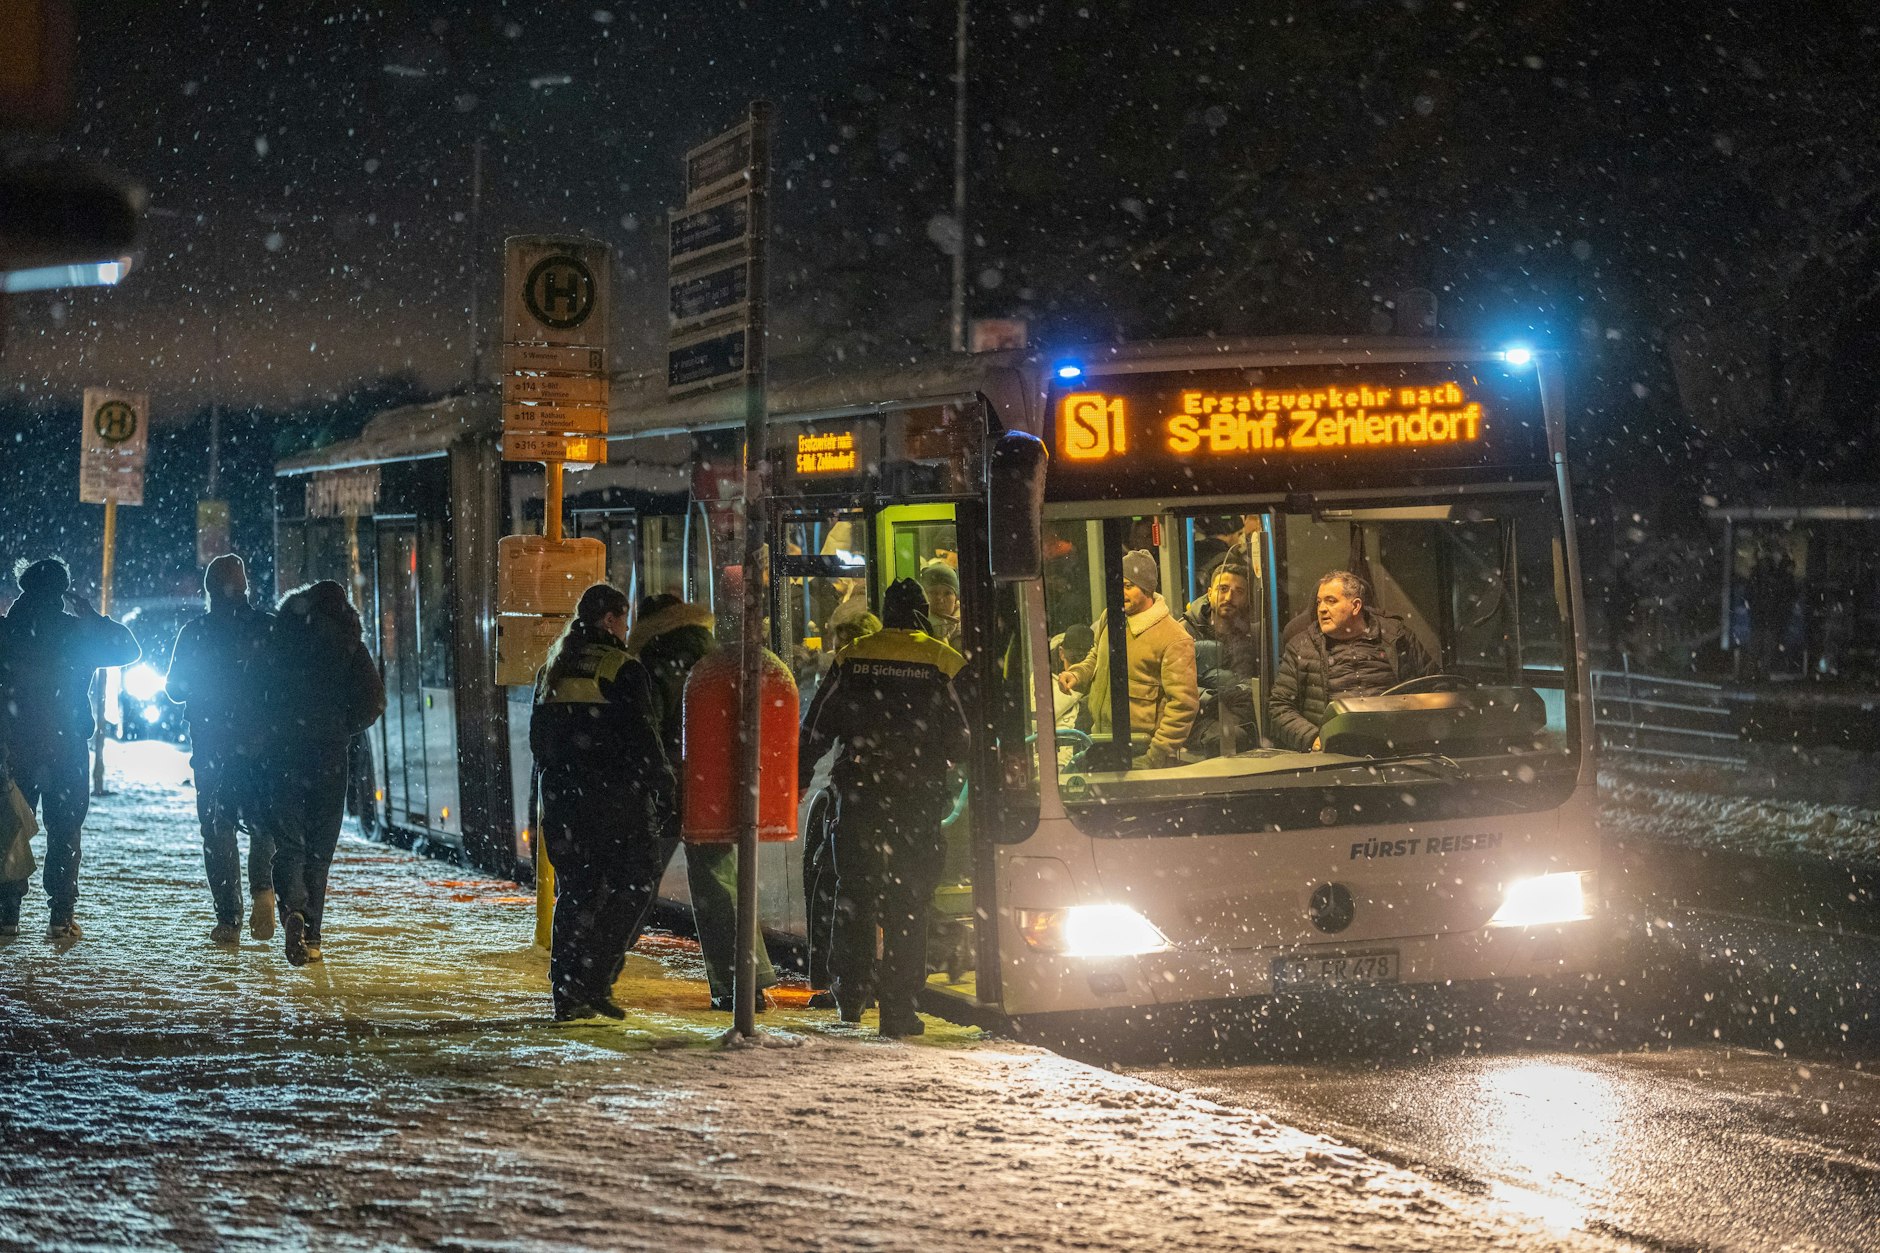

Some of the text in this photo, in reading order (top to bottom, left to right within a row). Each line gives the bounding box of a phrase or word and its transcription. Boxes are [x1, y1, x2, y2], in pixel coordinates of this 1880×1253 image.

[545, 272, 577, 312] H
[522, 382, 536, 391] 114
[1184, 388, 1391, 415] Ersatzverkehr
[1401, 384, 1461, 405] nach
[521, 412, 535, 421] 118
[521, 441, 537, 450] 316
[853, 664, 930, 679] DB Sicherheit
[1350, 832, 1503, 860] FÜRST REISEN
[1322, 960, 1347, 981] FR
[1353, 957, 1388, 978] 478
